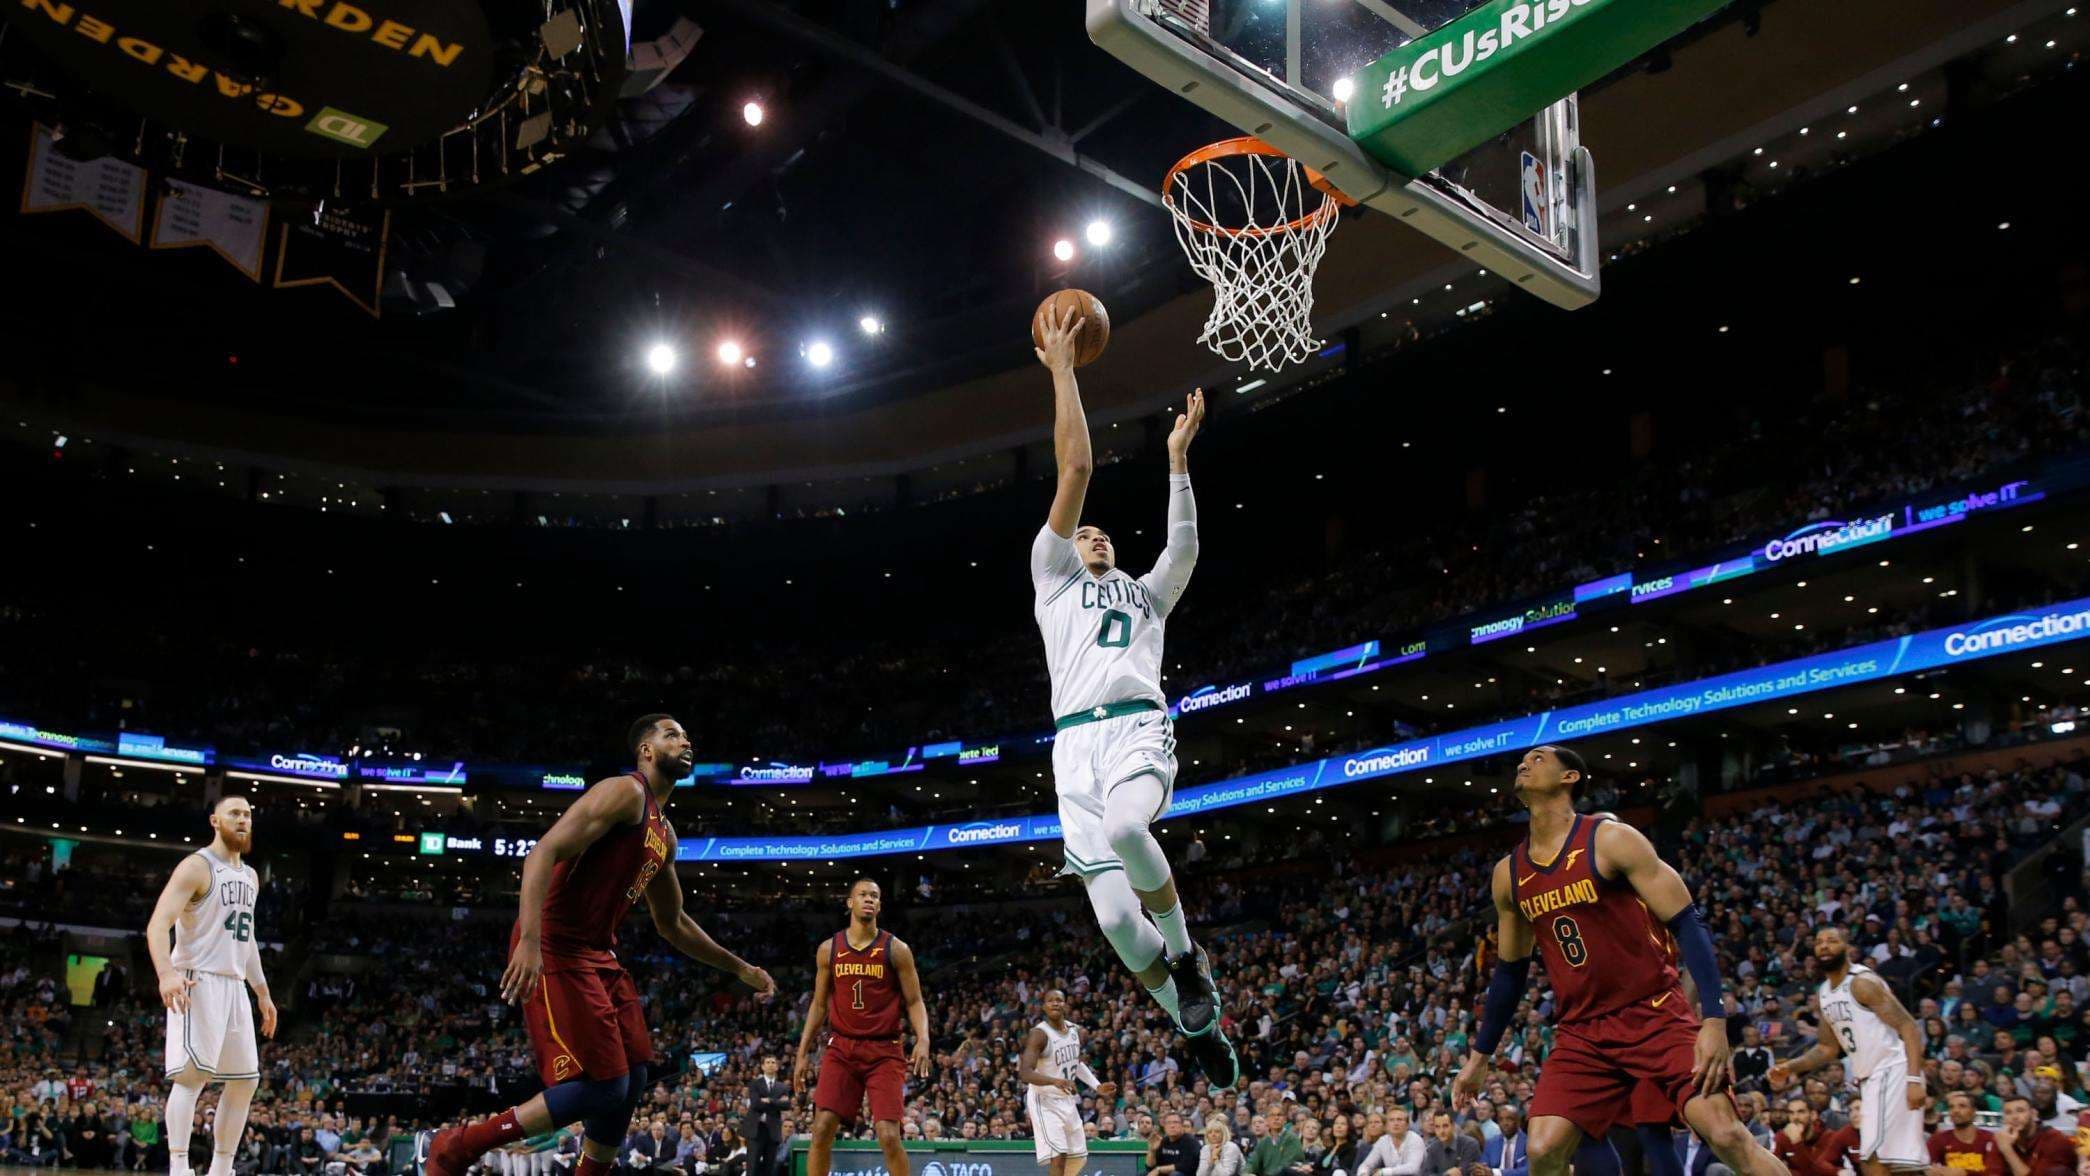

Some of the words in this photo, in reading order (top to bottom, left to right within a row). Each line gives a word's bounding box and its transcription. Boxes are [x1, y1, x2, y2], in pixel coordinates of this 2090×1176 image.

[1918, 507, 1947, 522] we
[1948, 492, 1998, 514] solve
[1097, 609, 1132, 648] 0
[1944, 609, 2090, 656] Connection
[1180, 684, 1251, 713] Connection
[1558, 711, 1621, 734] Complete
[1622, 696, 1701, 721] Technology
[1704, 682, 1774, 705] Solutions
[1776, 671, 1807, 690] and
[1809, 660, 1878, 684] Services
[1445, 746, 1461, 757] we
[1464, 736, 1495, 754] solve
[271, 754, 348, 776] Connection
[741, 765, 813, 781] Connection
[1344, 747, 1429, 777] Connection
[1202, 786, 1245, 805] Solutions
[1246, 781, 1264, 796] and
[1265, 776, 1306, 793] Services
[447, 838, 482, 850] Bank
[948, 824, 1022, 843] Connection
[1034, 826, 1049, 836] we
[719, 845, 764, 857] Complete
[765, 844, 819, 857] Technology
[820, 842, 860, 855] Solutions
[862, 840, 879, 851] and
[880, 838, 915, 851] Services
[1519, 878, 1599, 922] CLEVELAND
[224, 910, 253, 942] 46
[1552, 915, 1588, 968] 8
[835, 963, 884, 979] CLEVELAND
[851, 979, 864, 1010] 1
